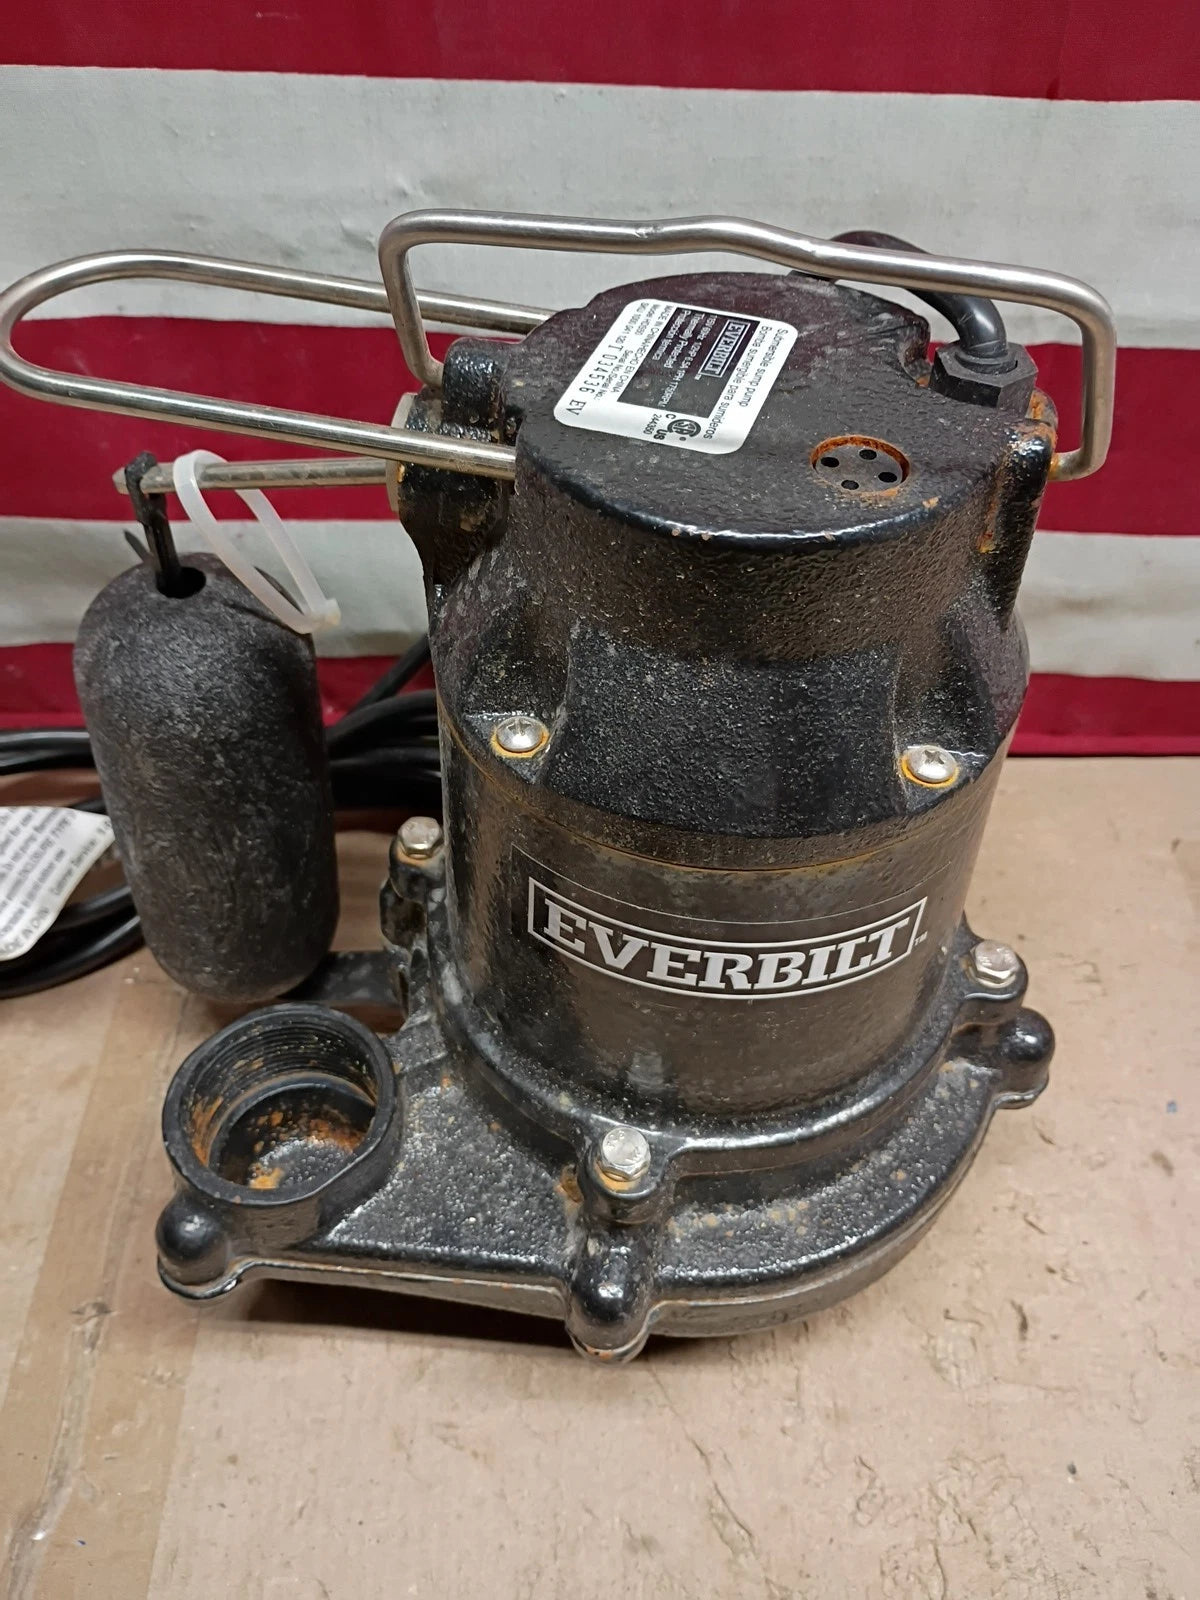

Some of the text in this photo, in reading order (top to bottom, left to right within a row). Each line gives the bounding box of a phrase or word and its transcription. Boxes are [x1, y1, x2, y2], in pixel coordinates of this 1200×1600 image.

[657, 304, 674, 321] MADE
[663, 339, 689, 369] Protected
[704, 324, 745, 375] EVERBILT
[578, 353, 618, 394] 034536
[610, 374, 630, 393] CHINA
[623, 365, 636, 375] EN
[701, 325, 773, 441] Bomba sumergible para sumideros
[737, 328, 789, 408] Submersible sump pump
[565, 399, 587, 416] EV
[543, 898, 910, 990] EVERBILT
